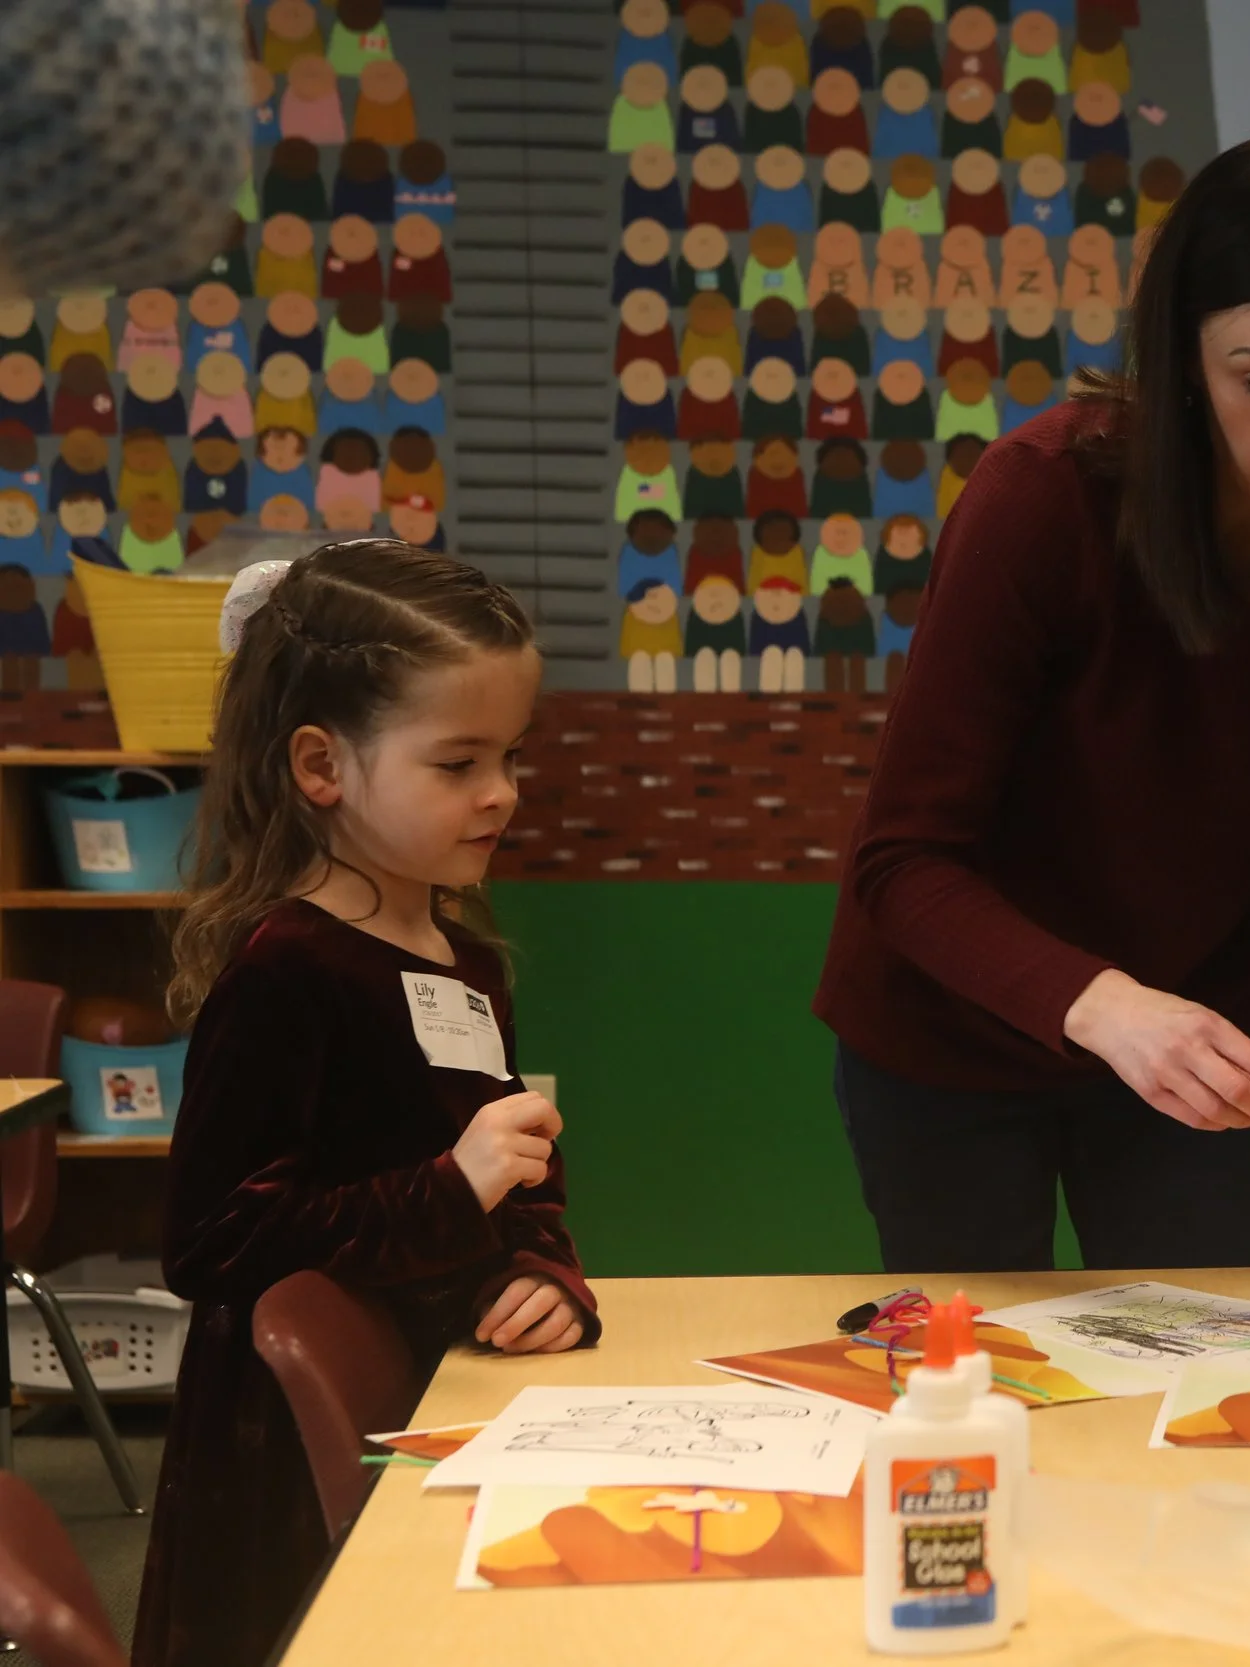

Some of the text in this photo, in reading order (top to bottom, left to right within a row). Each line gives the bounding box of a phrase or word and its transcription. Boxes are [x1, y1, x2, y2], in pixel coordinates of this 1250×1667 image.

[414, 982, 436, 999] Lily
[418, 998, 438, 1009] Engle
[908, 1537, 982, 1563] School
[914, 1560, 967, 1585] Glue
